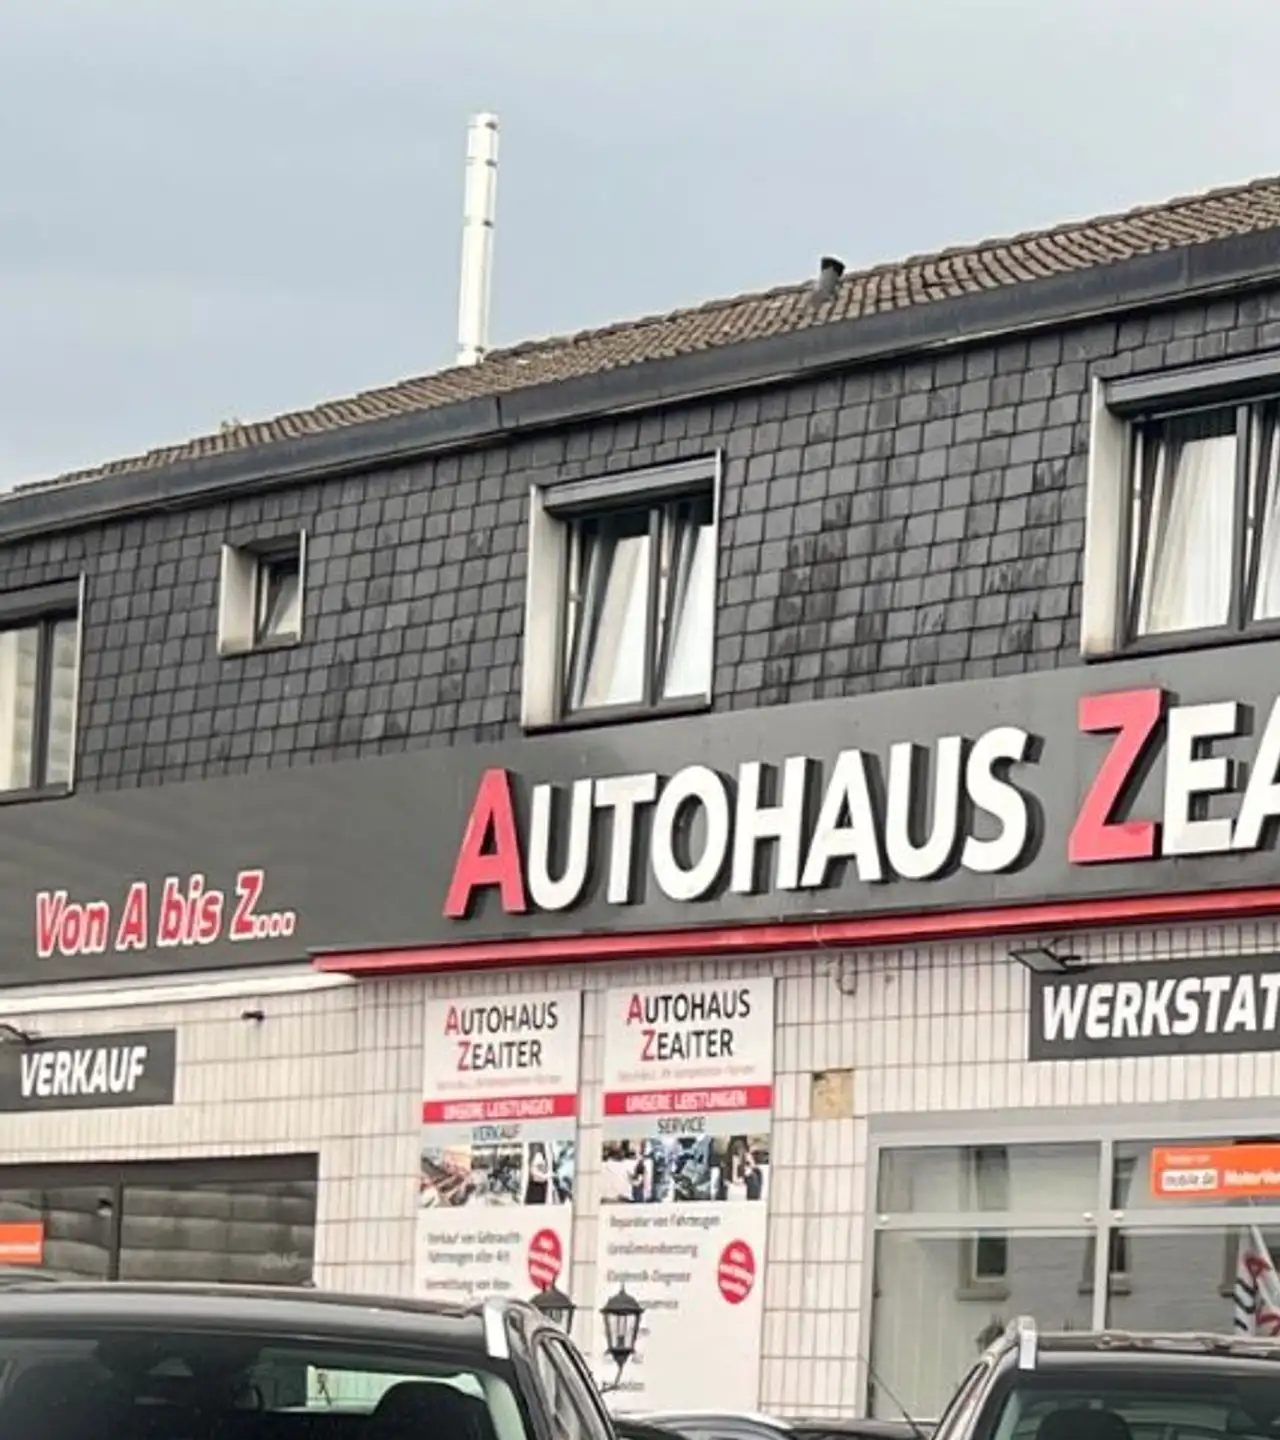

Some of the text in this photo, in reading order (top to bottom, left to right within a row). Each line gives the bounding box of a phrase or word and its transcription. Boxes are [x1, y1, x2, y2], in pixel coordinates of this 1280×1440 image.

[442, 725, 1034, 919] AUTOHAUS
[36, 868, 297, 958] Von A bis Z...
[444, 1001, 558, 1036] AUTOHAUS
[627, 989, 750, 1026] AUTOHAUS
[457, 1039, 543, 1072] ZEAITER
[641, 1029, 734, 1062] ZEAITER
[20, 1046, 147, 1097] VERKAUF
